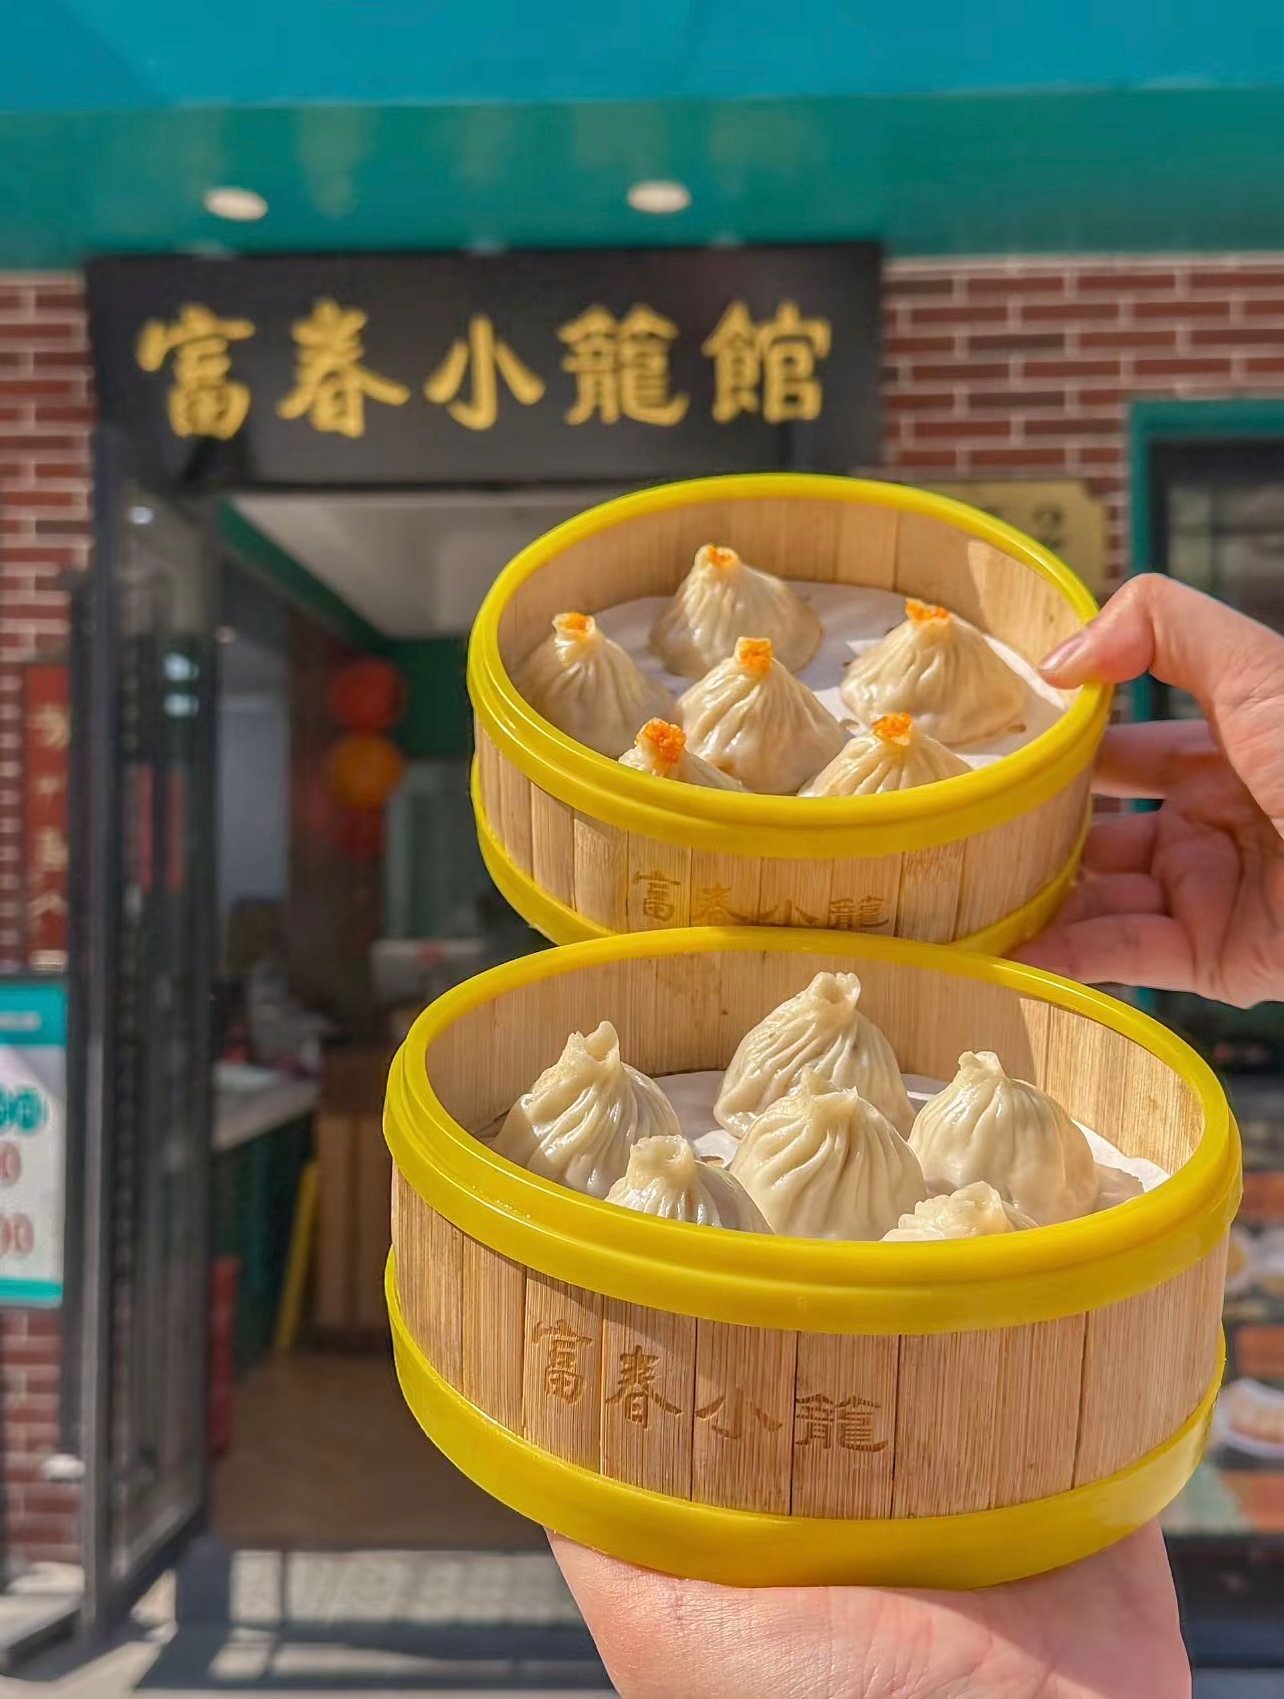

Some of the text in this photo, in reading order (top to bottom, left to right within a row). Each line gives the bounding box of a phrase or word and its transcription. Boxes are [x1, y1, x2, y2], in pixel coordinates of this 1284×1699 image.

[134, 297, 831, 440] 富春小籠館
[531, 1318, 889, 1453] 富春小籠
